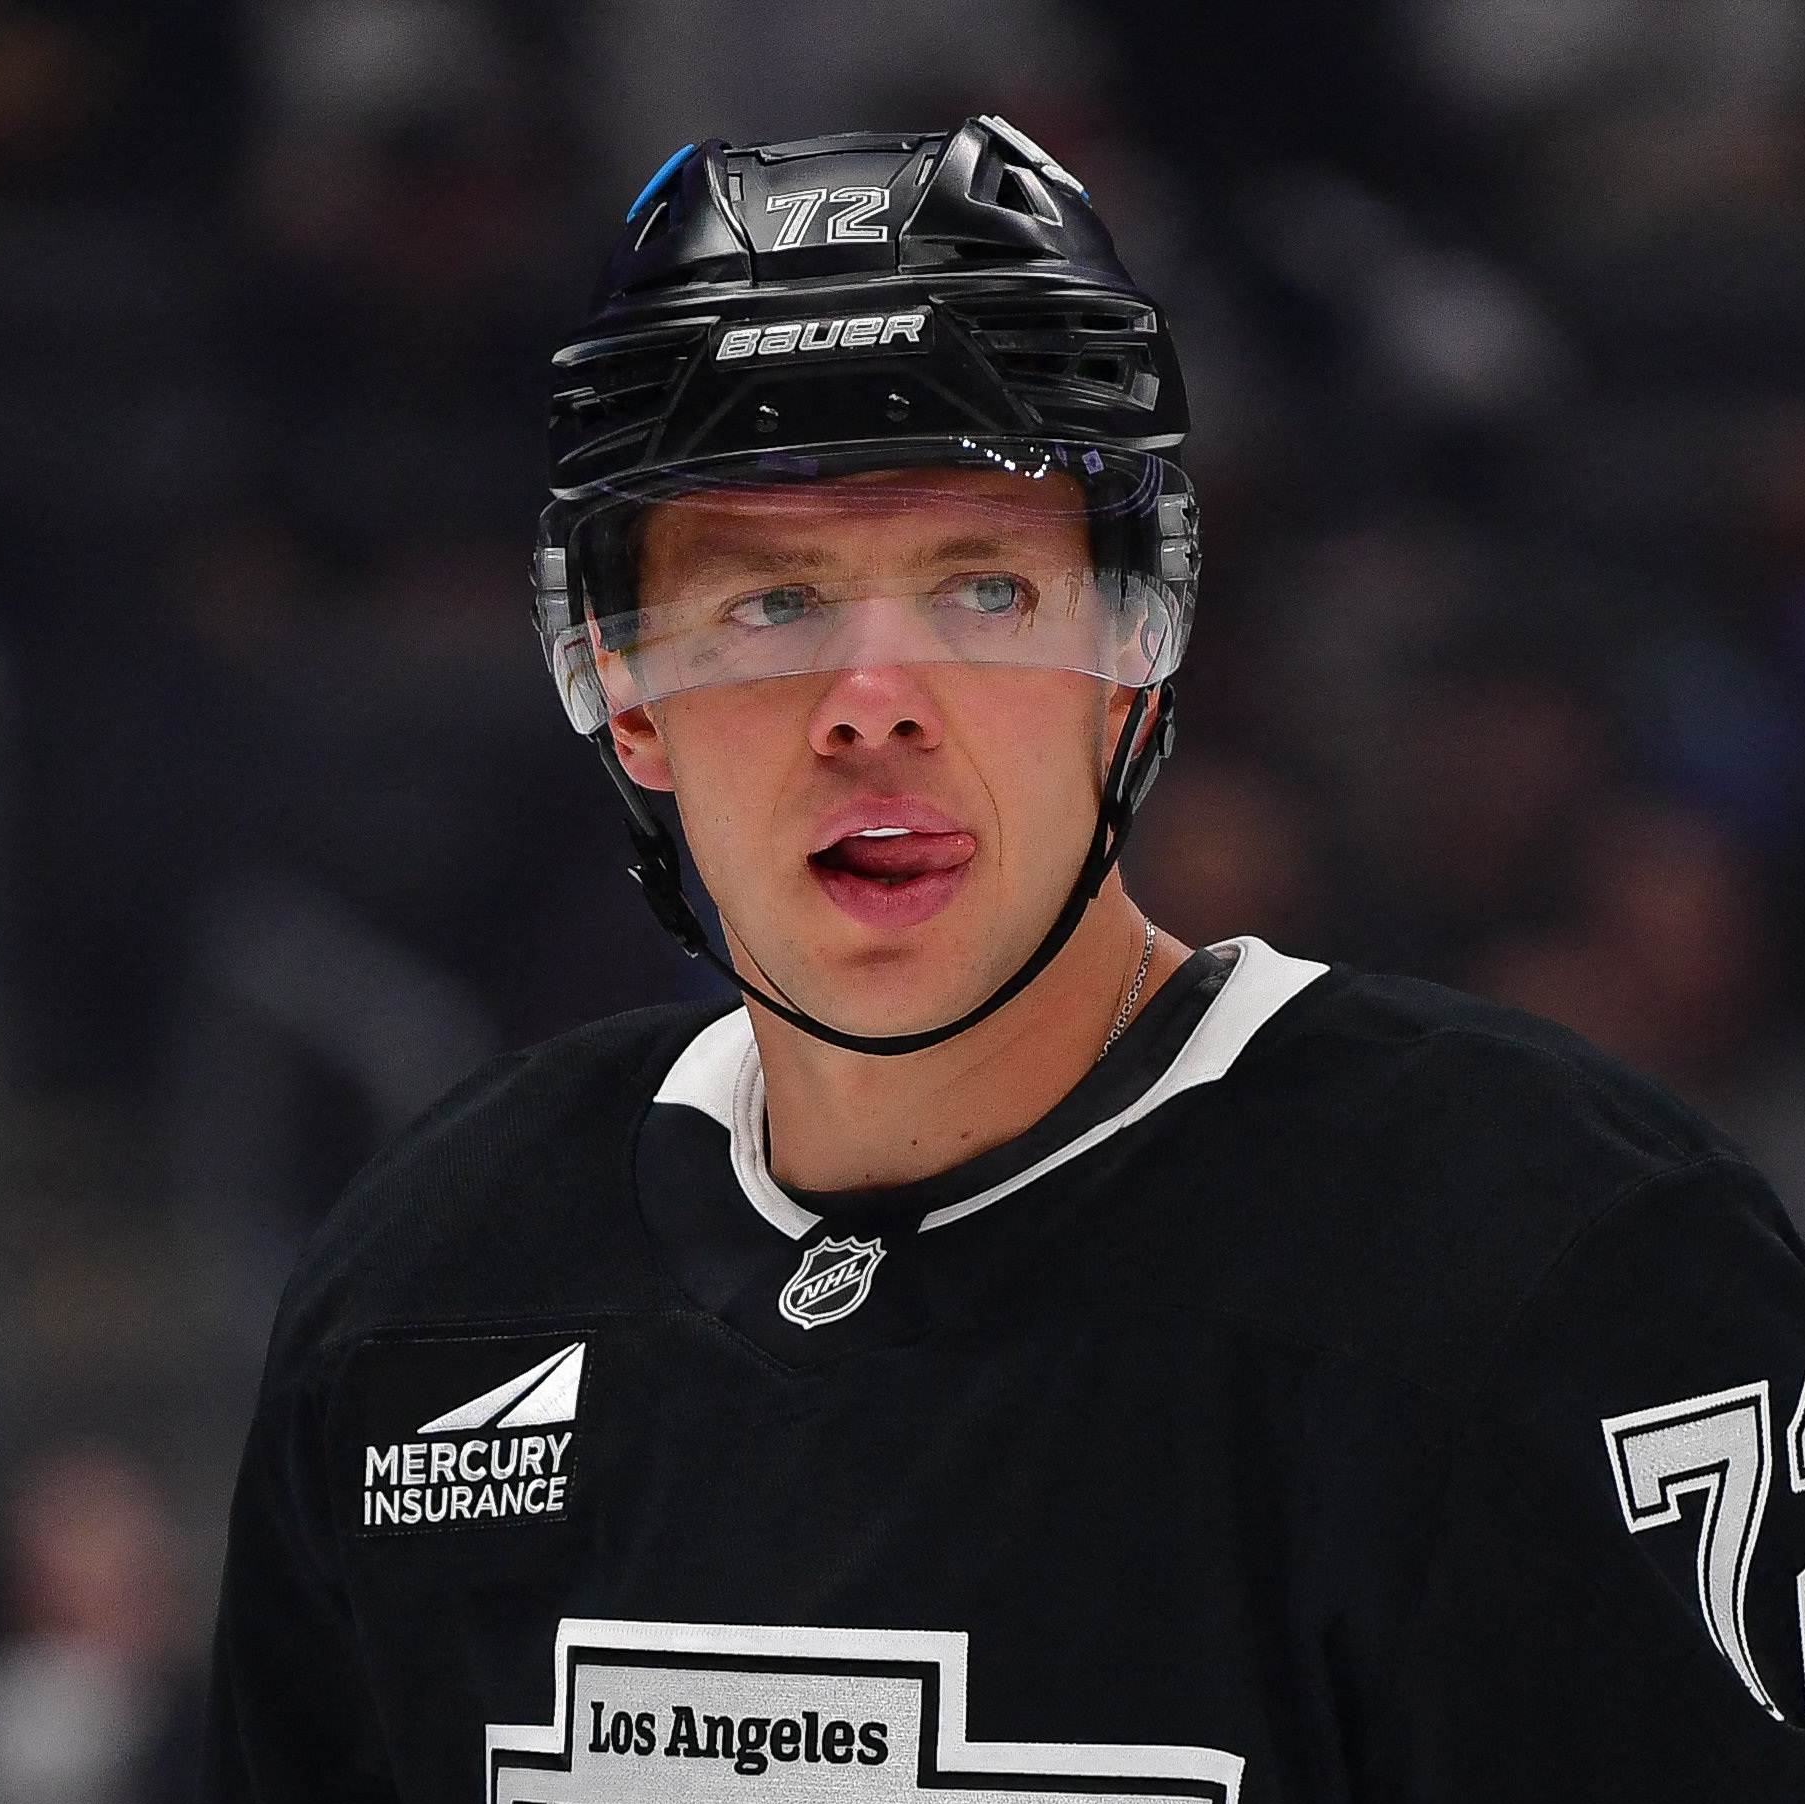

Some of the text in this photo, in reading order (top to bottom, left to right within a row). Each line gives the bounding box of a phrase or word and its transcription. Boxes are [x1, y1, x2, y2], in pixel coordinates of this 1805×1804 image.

[764, 187, 890, 251] 72
[796, 1261, 862, 1306] NHL
[364, 1432, 572, 1487] MERCURY
[364, 1476, 567, 1526] INSURANCE
[589, 1701, 889, 1776] Los Angeles
